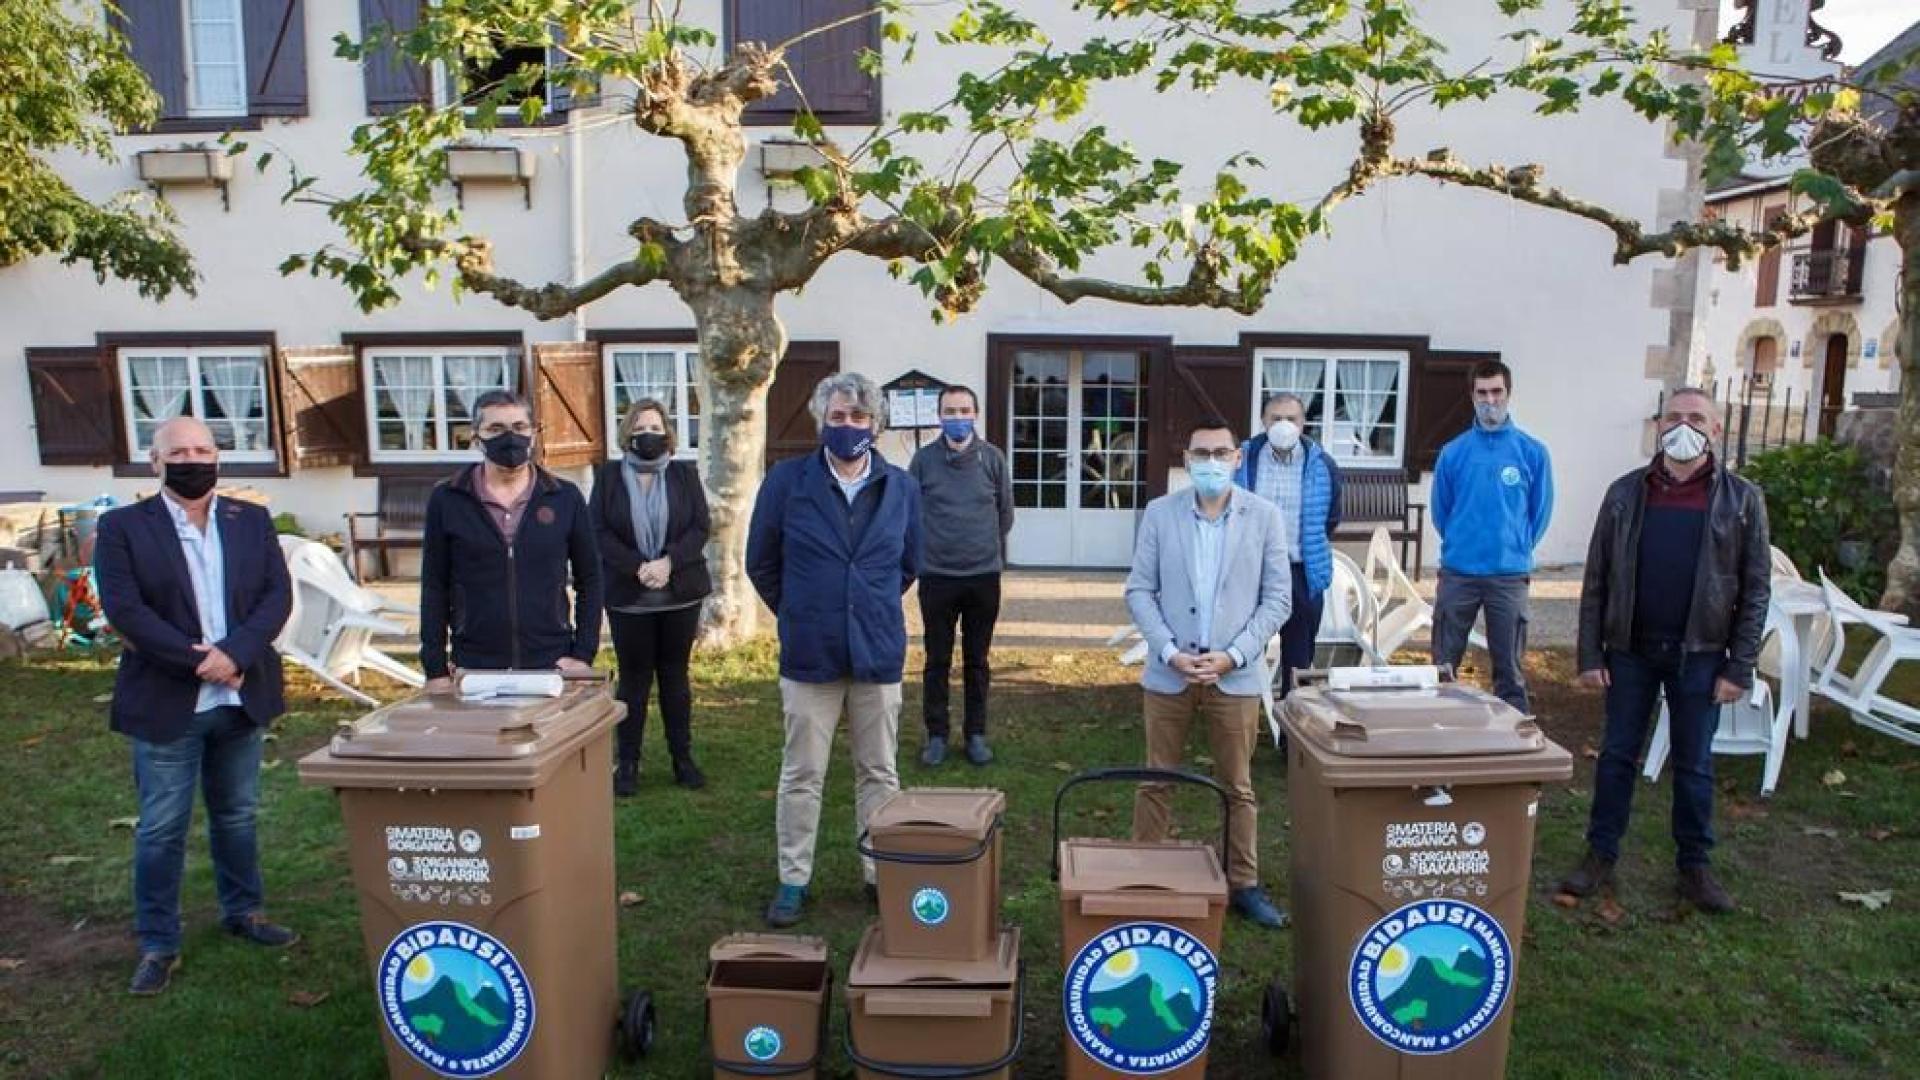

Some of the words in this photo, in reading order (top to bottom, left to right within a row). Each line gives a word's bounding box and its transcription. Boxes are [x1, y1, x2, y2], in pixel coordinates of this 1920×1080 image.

[395, 827, 455, 840] MATERIA
[1396, 822, 1457, 835] MATERIA
[423, 868, 490, 883] BAKARRIK
[1419, 860, 1490, 875] BAKARRIK
[396, 928, 506, 966] BIDAUSI
[1100, 928, 1213, 977] BIDAUSI
[1363, 904, 1477, 961] BIDAUSI
[385, 957, 445, 1067] MANCOMUNIDAD
[1070, 947, 1114, 1058] MANCOMUNIDAD
[1358, 960, 1436, 1048] MANCOMUNIDAD
